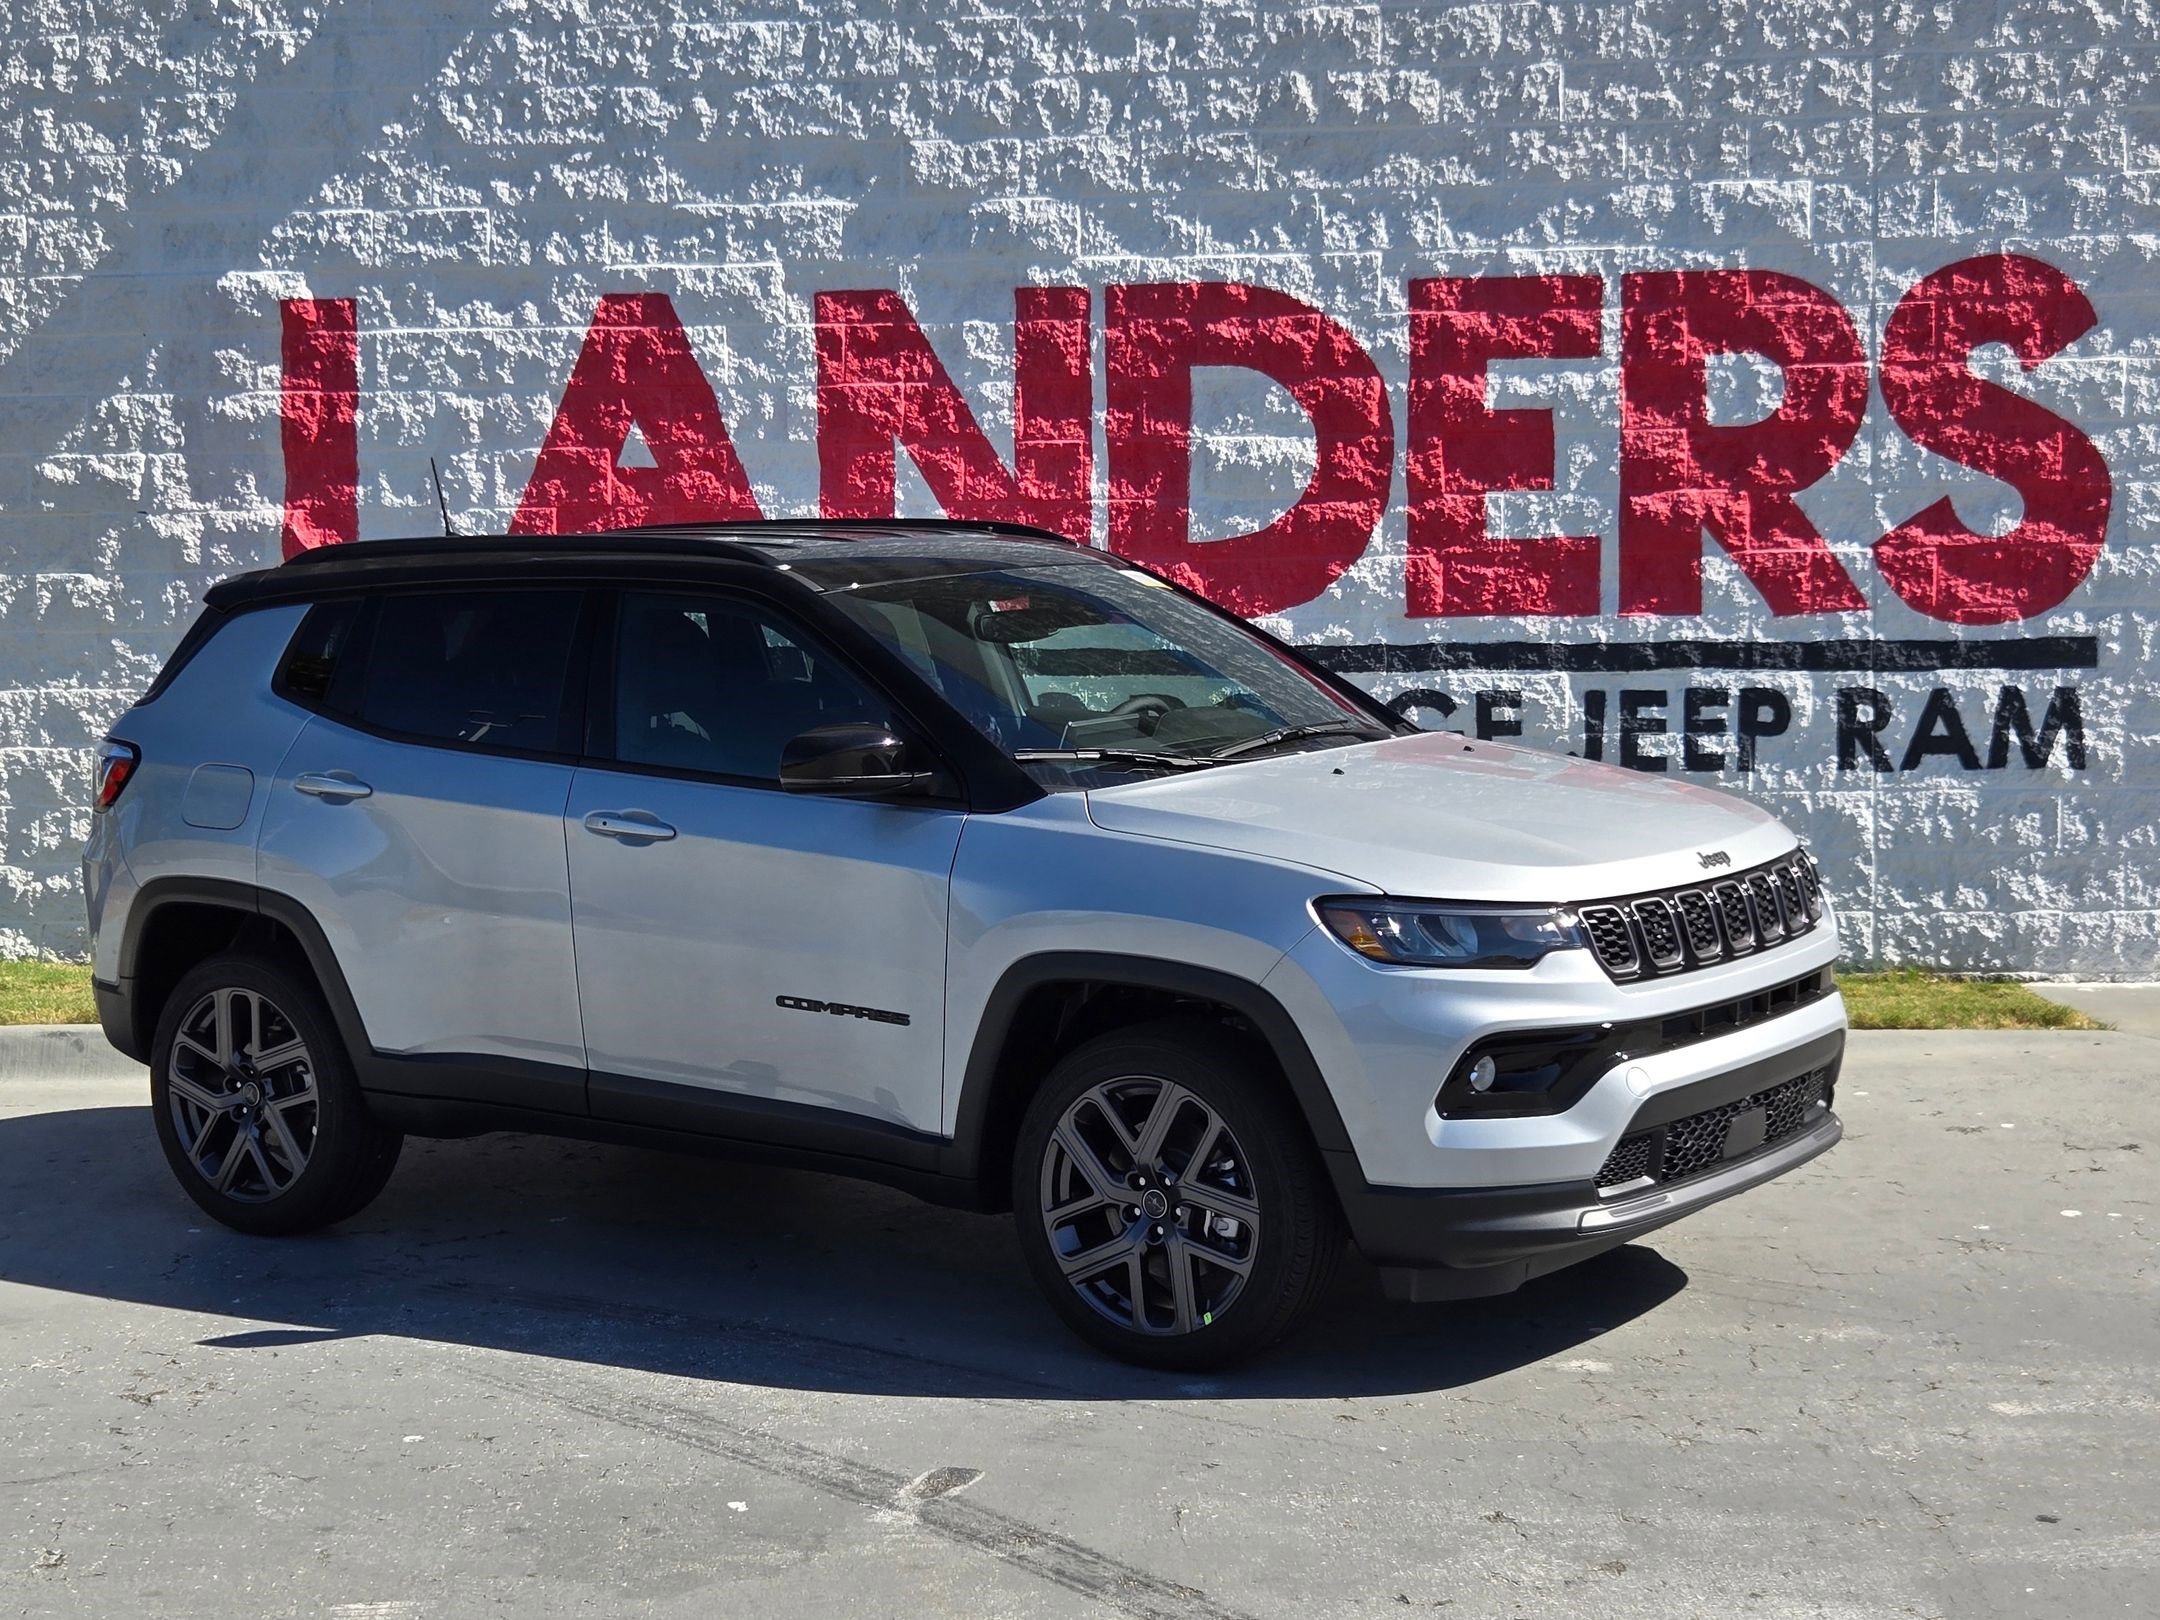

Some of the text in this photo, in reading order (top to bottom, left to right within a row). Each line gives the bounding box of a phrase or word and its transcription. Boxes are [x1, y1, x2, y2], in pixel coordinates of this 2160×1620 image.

[1566, 687, 1792, 773] JEEP
[1836, 686, 2087, 772] RAM
[1695, 850, 1732, 870] Jeep
[775, 995, 911, 1027] COMPASS
